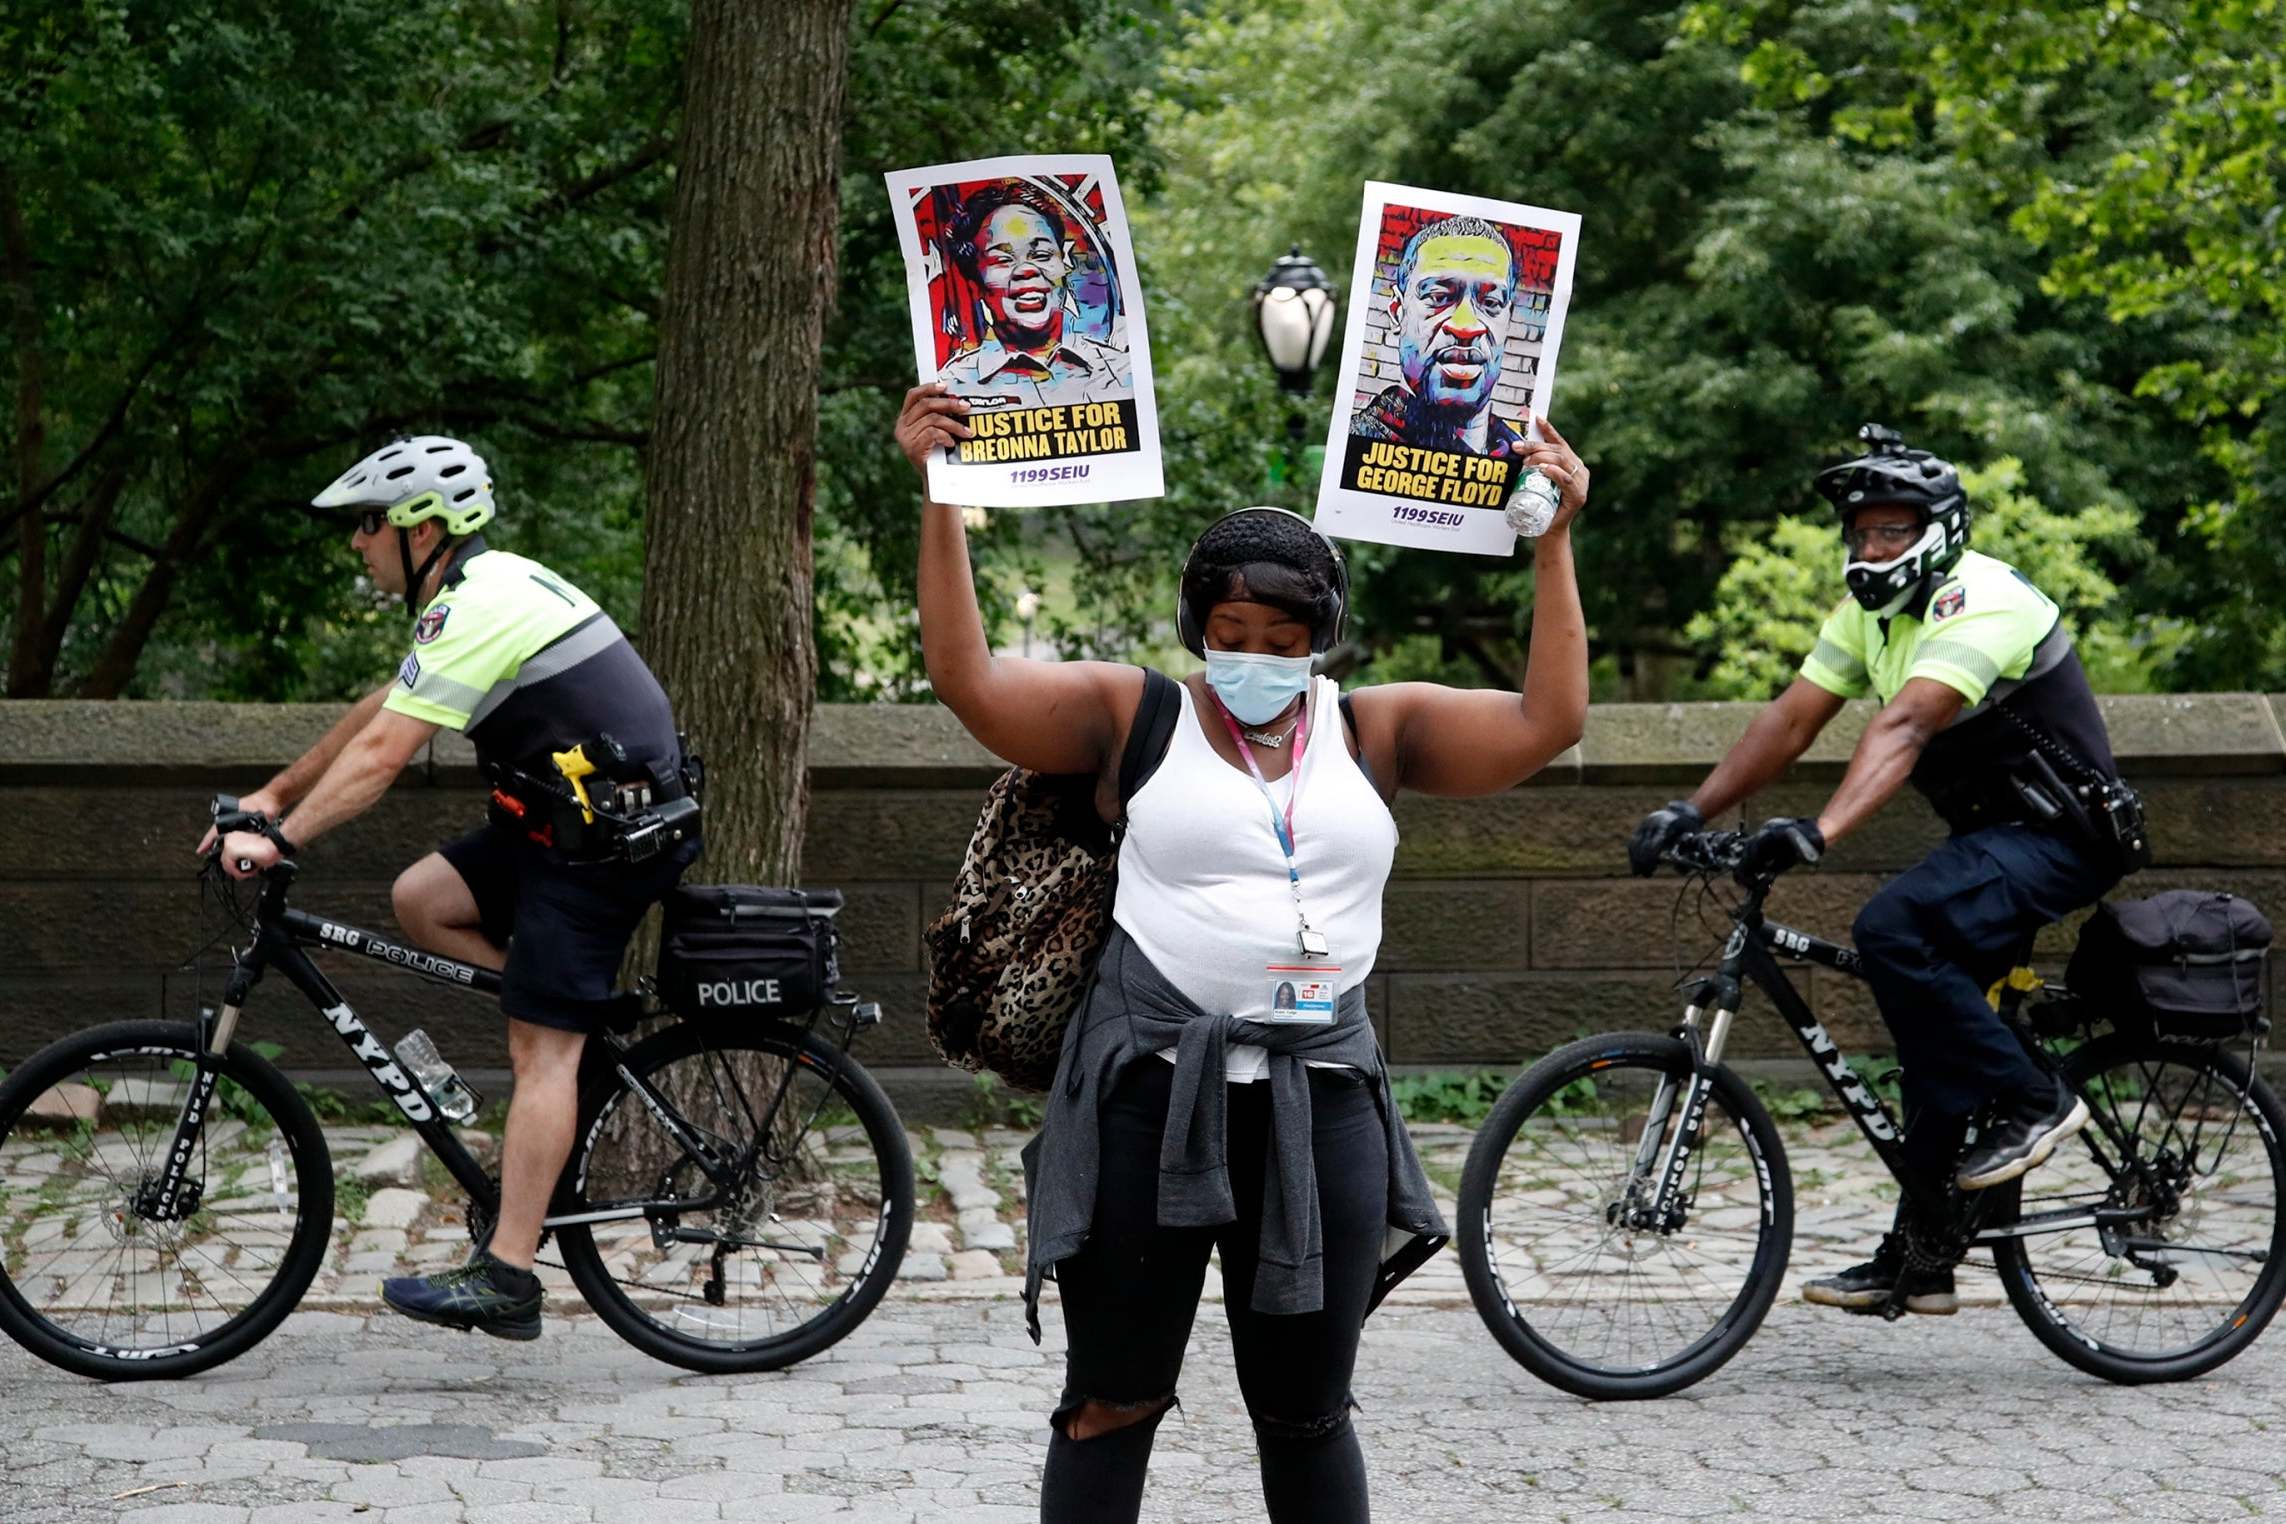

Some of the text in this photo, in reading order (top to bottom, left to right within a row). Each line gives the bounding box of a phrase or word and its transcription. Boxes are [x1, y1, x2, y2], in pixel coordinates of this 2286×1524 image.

[965, 402, 1122, 439] JUSTICE FOR
[959, 427, 1128, 463] BREONNA TAYLOR
[1361, 442, 1509, 483] JUSTICE FOR
[1009, 464, 1091, 484] 1199SEIU
[1356, 465, 1504, 507] GEORGE FLOYD
[1392, 506, 1465, 526] 1199SEIU
[319, 923, 475, 985] SRG POLICE
[1774, 928, 1811, 952] SRG
[697, 979, 782, 1006] POLICE
[321, 1002, 433, 1122] NYPD
[1800, 1022, 1897, 1141] NYPD
[155, 1138, 191, 1218] POLICE
